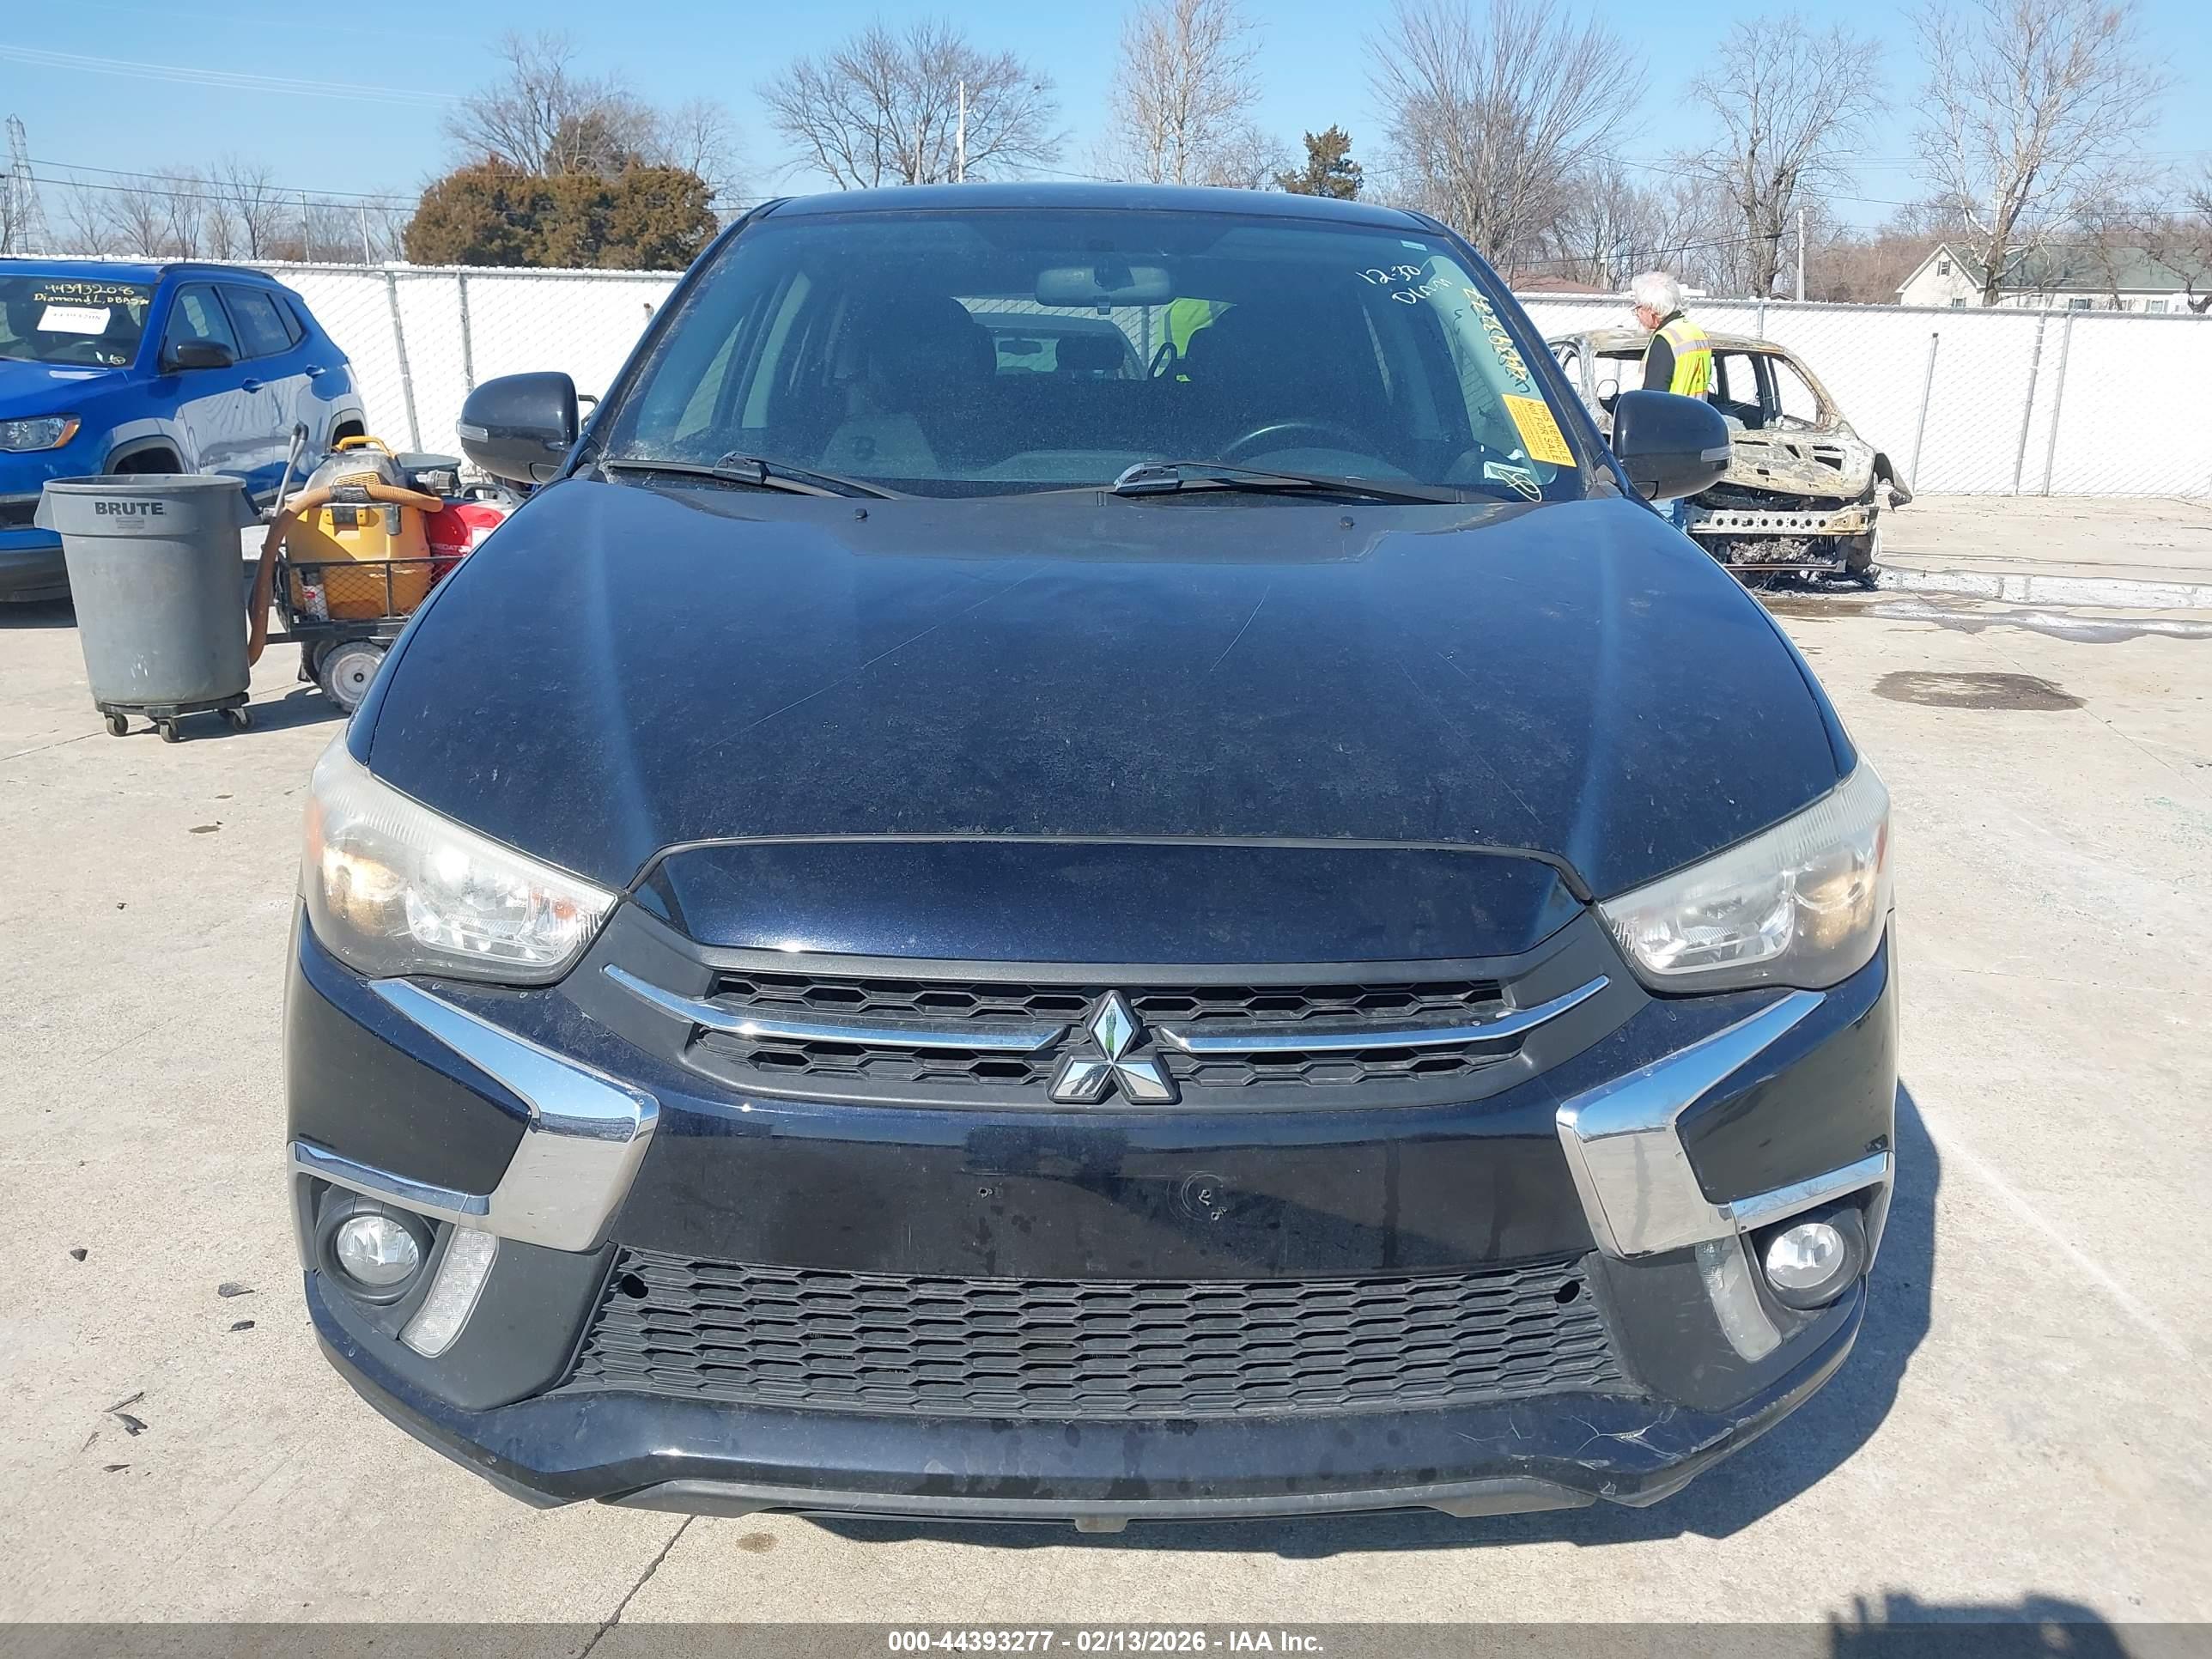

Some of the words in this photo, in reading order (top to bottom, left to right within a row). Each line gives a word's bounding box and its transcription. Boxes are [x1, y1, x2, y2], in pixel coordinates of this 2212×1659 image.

[1534, 416, 1549, 435] FOR
[1544, 437, 1562, 461] SALE
[1537, 404, 1553, 422] THIS
[1547, 424, 1572, 462] VEHICLE
[94, 501, 166, 515] BRUTE
